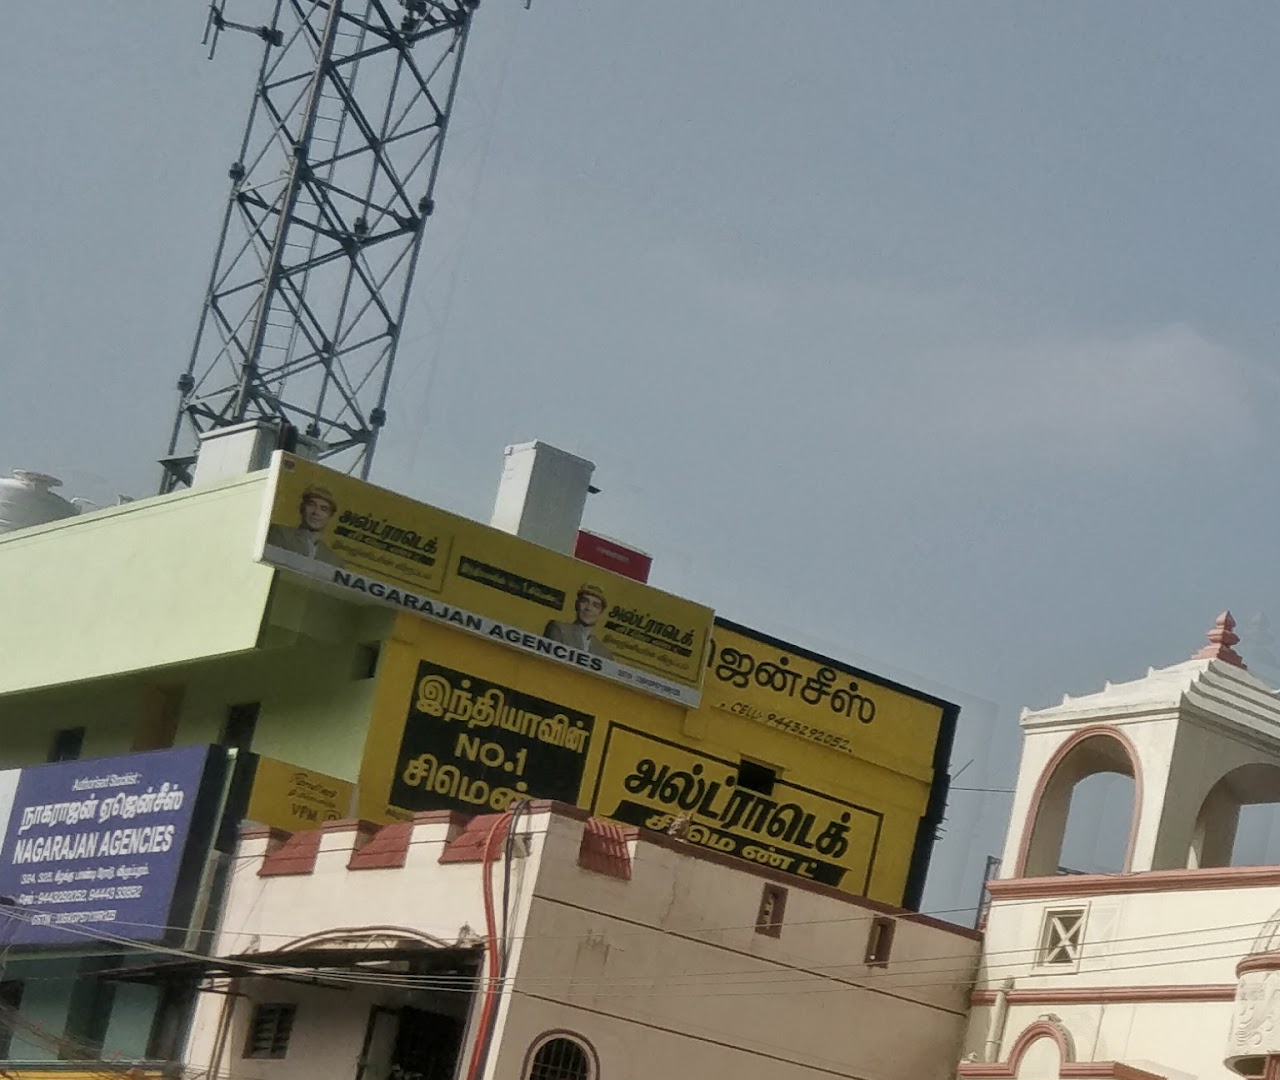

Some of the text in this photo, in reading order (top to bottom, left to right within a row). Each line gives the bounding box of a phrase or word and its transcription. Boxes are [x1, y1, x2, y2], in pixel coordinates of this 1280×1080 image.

[333, 569, 482, 631] NAGARAJAN
[489, 625, 603, 671] AGENCIES
[416, 674, 590, 754] இந்தியாவின்
[706, 638, 876, 724] ஜென்சீஸ்
[453, 733, 528, 776] NO.1
[12, 825, 175, 864] NAGARAJAN AGENCIES
[18, 793, 99, 835] நாகராஜன்
[624, 758, 853, 859] அல்ட்ராடெக்
